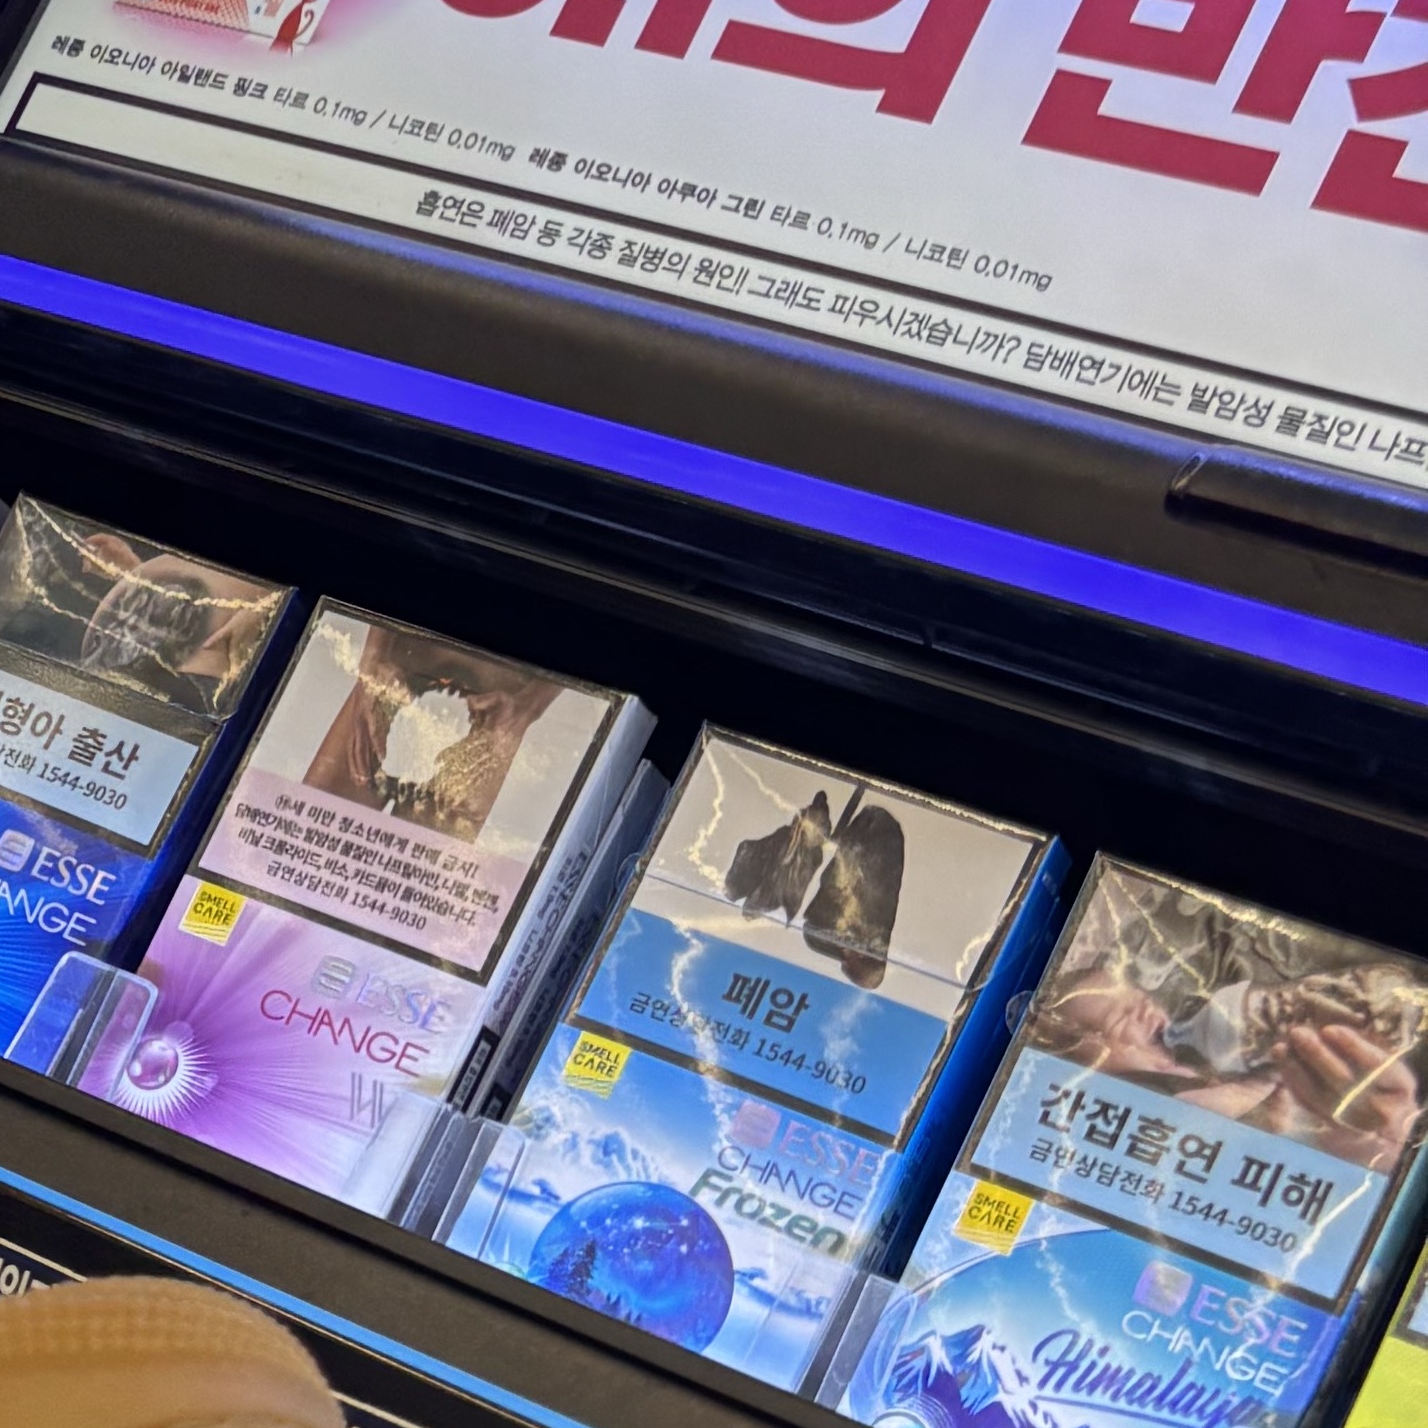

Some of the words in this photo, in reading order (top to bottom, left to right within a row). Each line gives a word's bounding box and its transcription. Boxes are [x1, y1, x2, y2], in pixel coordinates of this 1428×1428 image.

[51, 33, 86, 60] 레종
[89, 42, 157, 76] 이오니아
[160, 57, 231, 93] 아일랜드
[232, 76, 268, 101] 핑크
[272, 86, 311, 111] 타르
[312, 94, 369, 128] 0.1mg
[388, 112, 447, 143] 니코틴
[446, 125, 517, 164] 0.01mg
[527, 147, 569, 177] 레종
[573, 157, 653, 195] 이오니아
[656, 176, 719, 211] 아쿠아
[720, 193, 768, 223] 그린
[769, 203, 814, 235] 타르
[815, 214, 882, 253] 0.1mg
[904, 235, 971, 272] 니코틴
[973, 252, 1054, 294] 0.01mg
[415, 188, 486, 230] 흡연은
[485, 206, 539, 243] 폐암
[535, 218, 565, 250] 등
[565, 225, 617, 263] 각종
[618, 237, 694, 282] 질병의
[692, 257, 751, 296] 원인!
[747, 270, 827, 313] 그래도
[827, 289, 1022, 368] 피우시겠습니까?
[1022, 341, 1183, 407] 담배연기에는
[1187, 381, 1276, 429] 발암성
[1274, 405, 1368, 452] 물질인
[1367, 426, 1428, 466] 나프
[35, 760, 130, 812] 1544-9030
[68, 722, 142, 783] 출산
[32, 843, 120, 908] ESSE
[258, 988, 433, 1078] CHANGE
[721, 971, 813, 1034] 폐암
[717, 1141, 864, 1220] CHANGE
[1027, 1135, 1170, 1208] 금연상담전화
[1166, 1187, 1301, 1257] 1544-9030
[1035, 1080, 1227, 1177] 간접흡연
[1232, 1150, 1337, 1229] 피해
[688, 1167, 849, 1255] Frozen
[1119, 1306, 1286, 1399] CHANGE
[1189, 1285, 1312, 1364] ESSE
